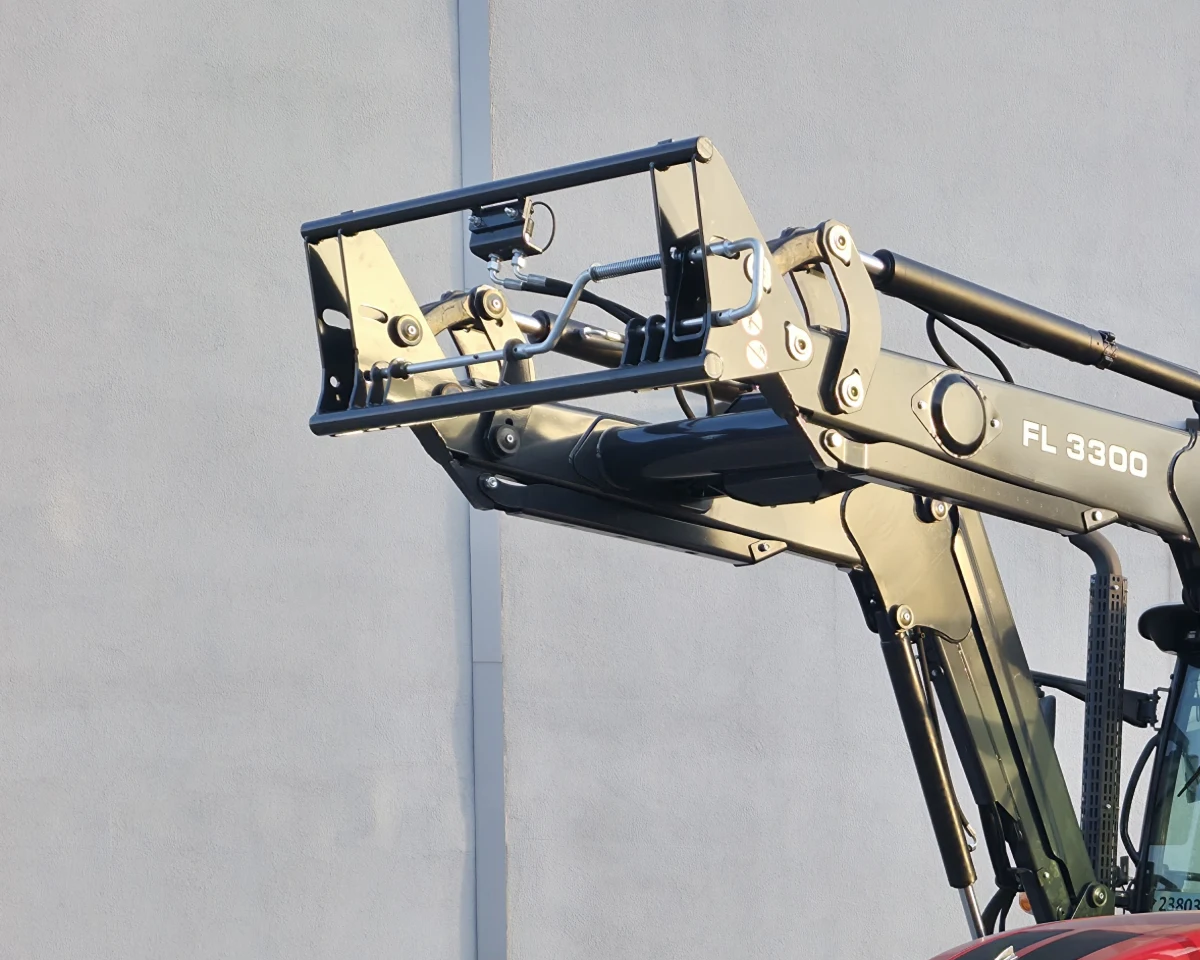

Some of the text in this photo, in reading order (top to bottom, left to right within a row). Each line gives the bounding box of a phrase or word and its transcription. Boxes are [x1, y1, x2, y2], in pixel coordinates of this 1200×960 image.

[1022, 419, 1148, 478] FL 3300
[1158, 896, 1200, 911] 23803
